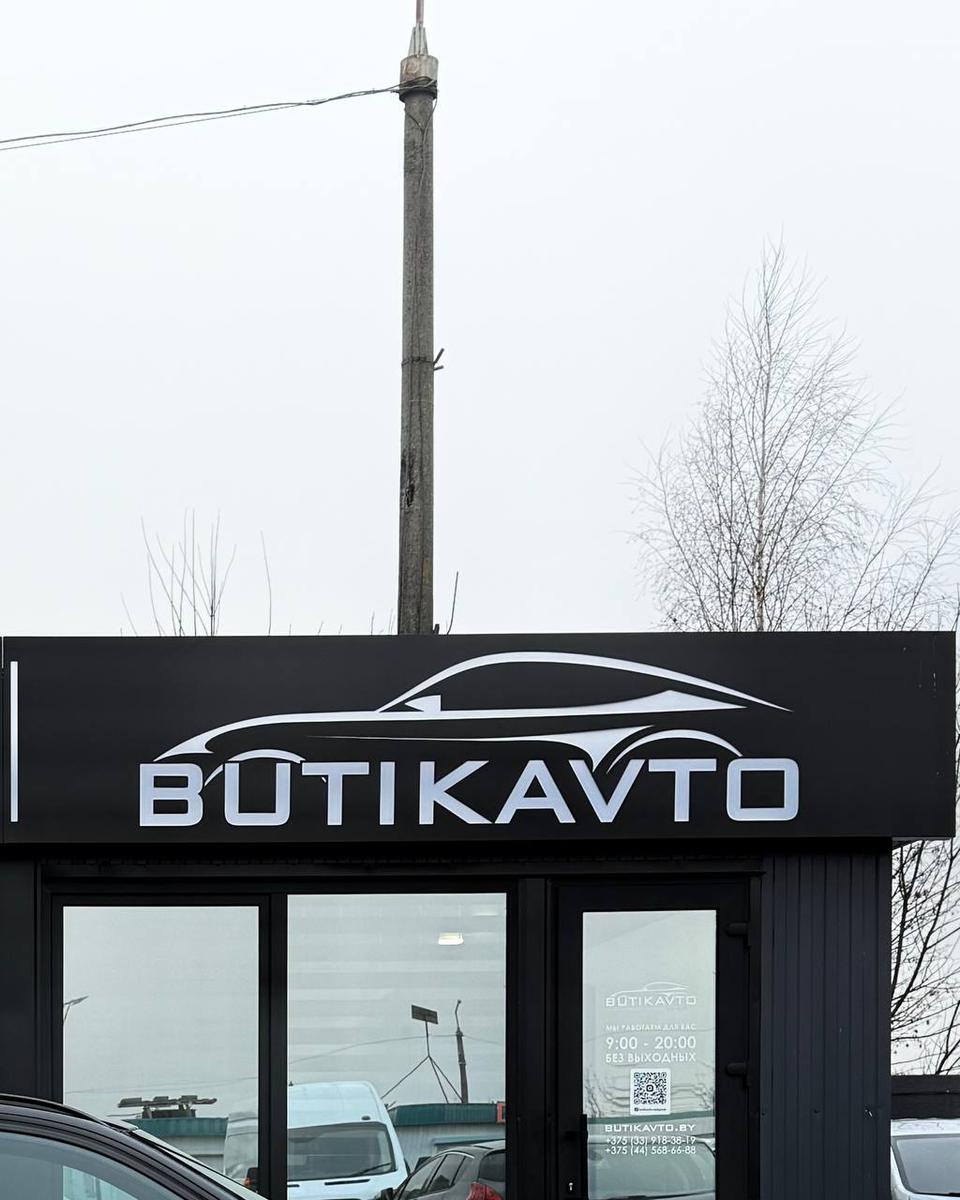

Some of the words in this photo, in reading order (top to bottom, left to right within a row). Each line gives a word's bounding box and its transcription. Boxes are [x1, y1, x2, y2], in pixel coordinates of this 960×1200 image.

[139, 757, 800, 827] BUTIKAVTO
[605, 995, 697, 1007] BUTIKAVTO
[606, 1036, 638, 1050] 9:00
[654, 1036, 697, 1049] 20:00
[605, 1053, 625, 1063] БЕЗ
[627, 1052, 697, 1063] ВЫХОДНЫХ
[605, 1124, 696, 1132] BUTIKAVTO.BY
[606, 1136, 628, 1145] +375
[630, 1136, 648, 1146] (33)
[605, 1146, 628, 1155] +375
[630, 1146, 648, 1156] (44)
[651, 1146, 697, 1155] 568-66-88
